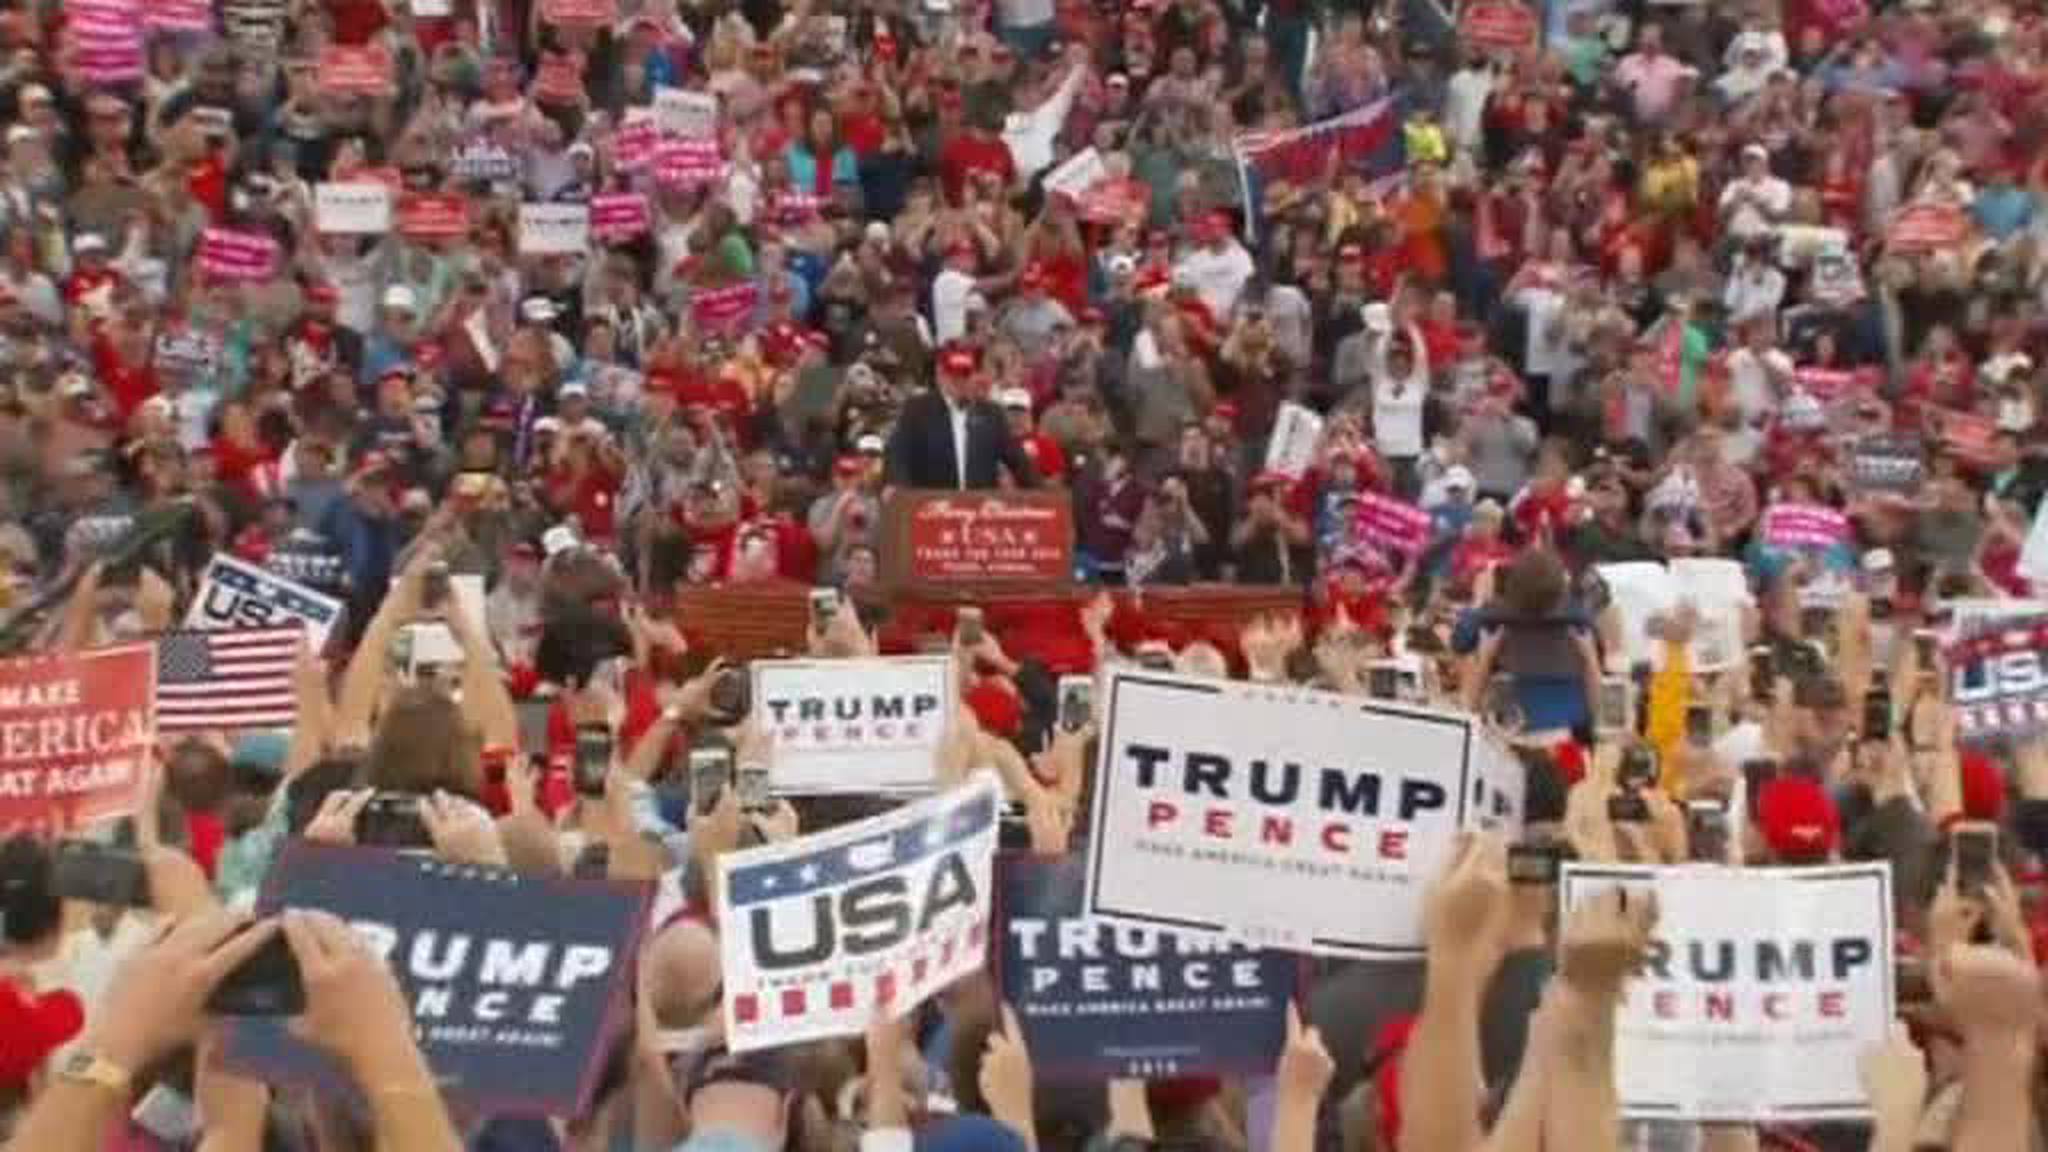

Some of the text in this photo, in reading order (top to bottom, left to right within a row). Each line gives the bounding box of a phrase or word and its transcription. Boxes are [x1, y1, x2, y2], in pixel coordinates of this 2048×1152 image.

[767, 693, 937, 724] TRUMP
[1126, 745, 1446, 819] TRUMP
[1147, 801, 1409, 859] PENCE
[751, 851, 976, 970] USA
[1032, 960, 1263, 992] PENCE
[1631, 937, 1871, 982] RUMP
[416, 986, 565, 1024] NCE
[1653, 991, 1846, 1020] ENCE
